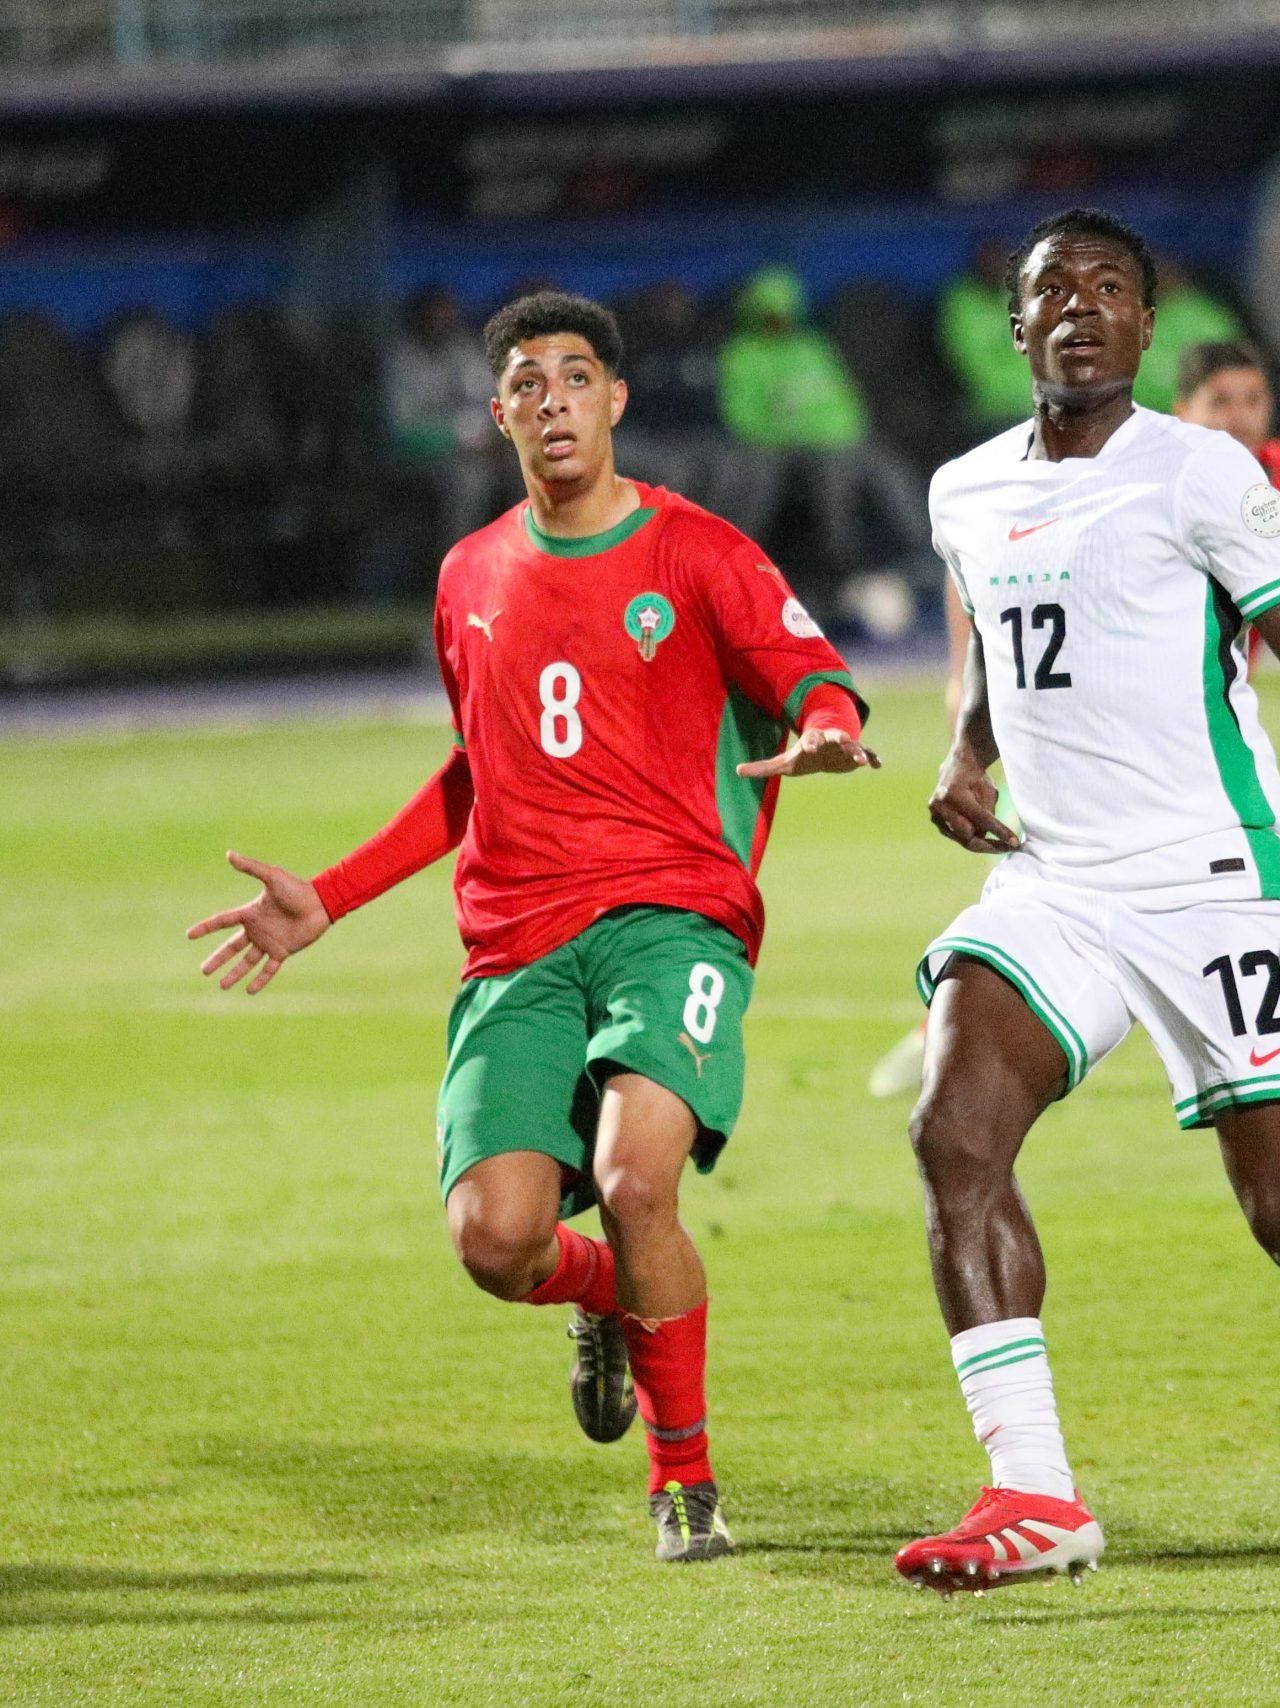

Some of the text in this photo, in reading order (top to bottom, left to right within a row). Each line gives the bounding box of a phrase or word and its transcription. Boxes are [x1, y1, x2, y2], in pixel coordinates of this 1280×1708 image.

[989, 571, 1070, 585] NAIJA
[1000, 603, 1072, 690] 12
[538, 661, 583, 759] 8
[682, 962, 725, 1044] 8
